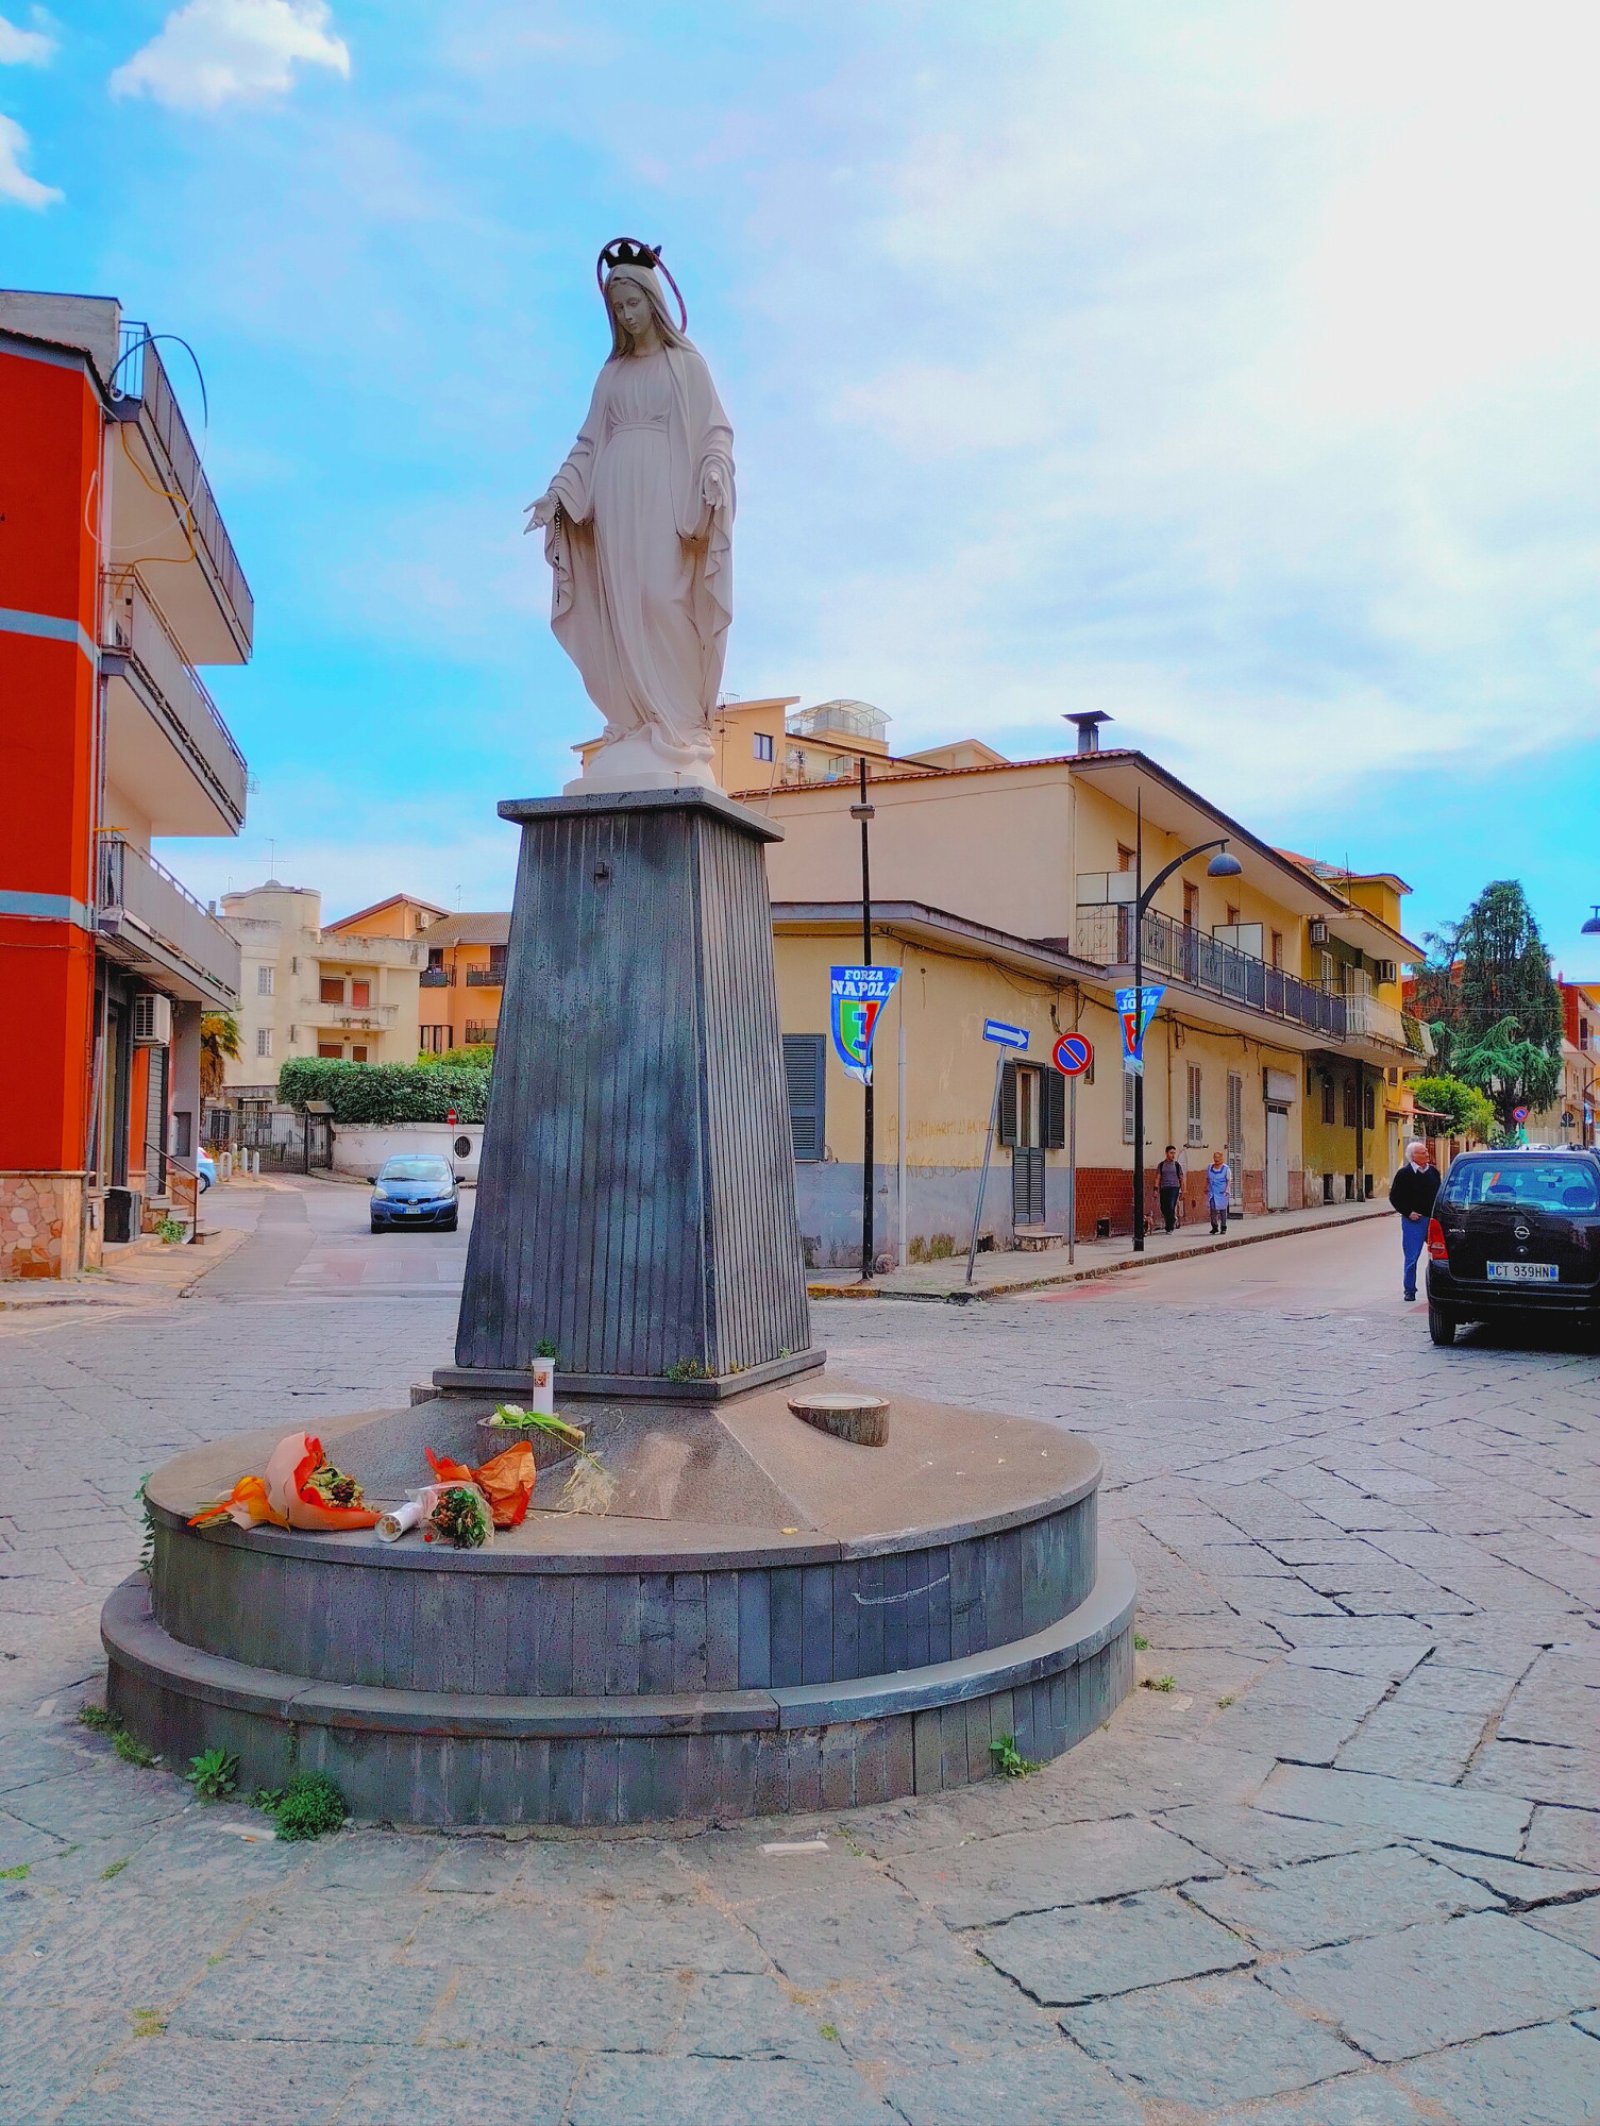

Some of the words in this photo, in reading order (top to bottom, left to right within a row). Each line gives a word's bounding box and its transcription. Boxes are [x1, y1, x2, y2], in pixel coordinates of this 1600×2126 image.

[844, 970, 884, 980] FORZA
[1495, 1265, 1509, 1277] CT
[1514, 1265, 1550, 1278] 939HN
